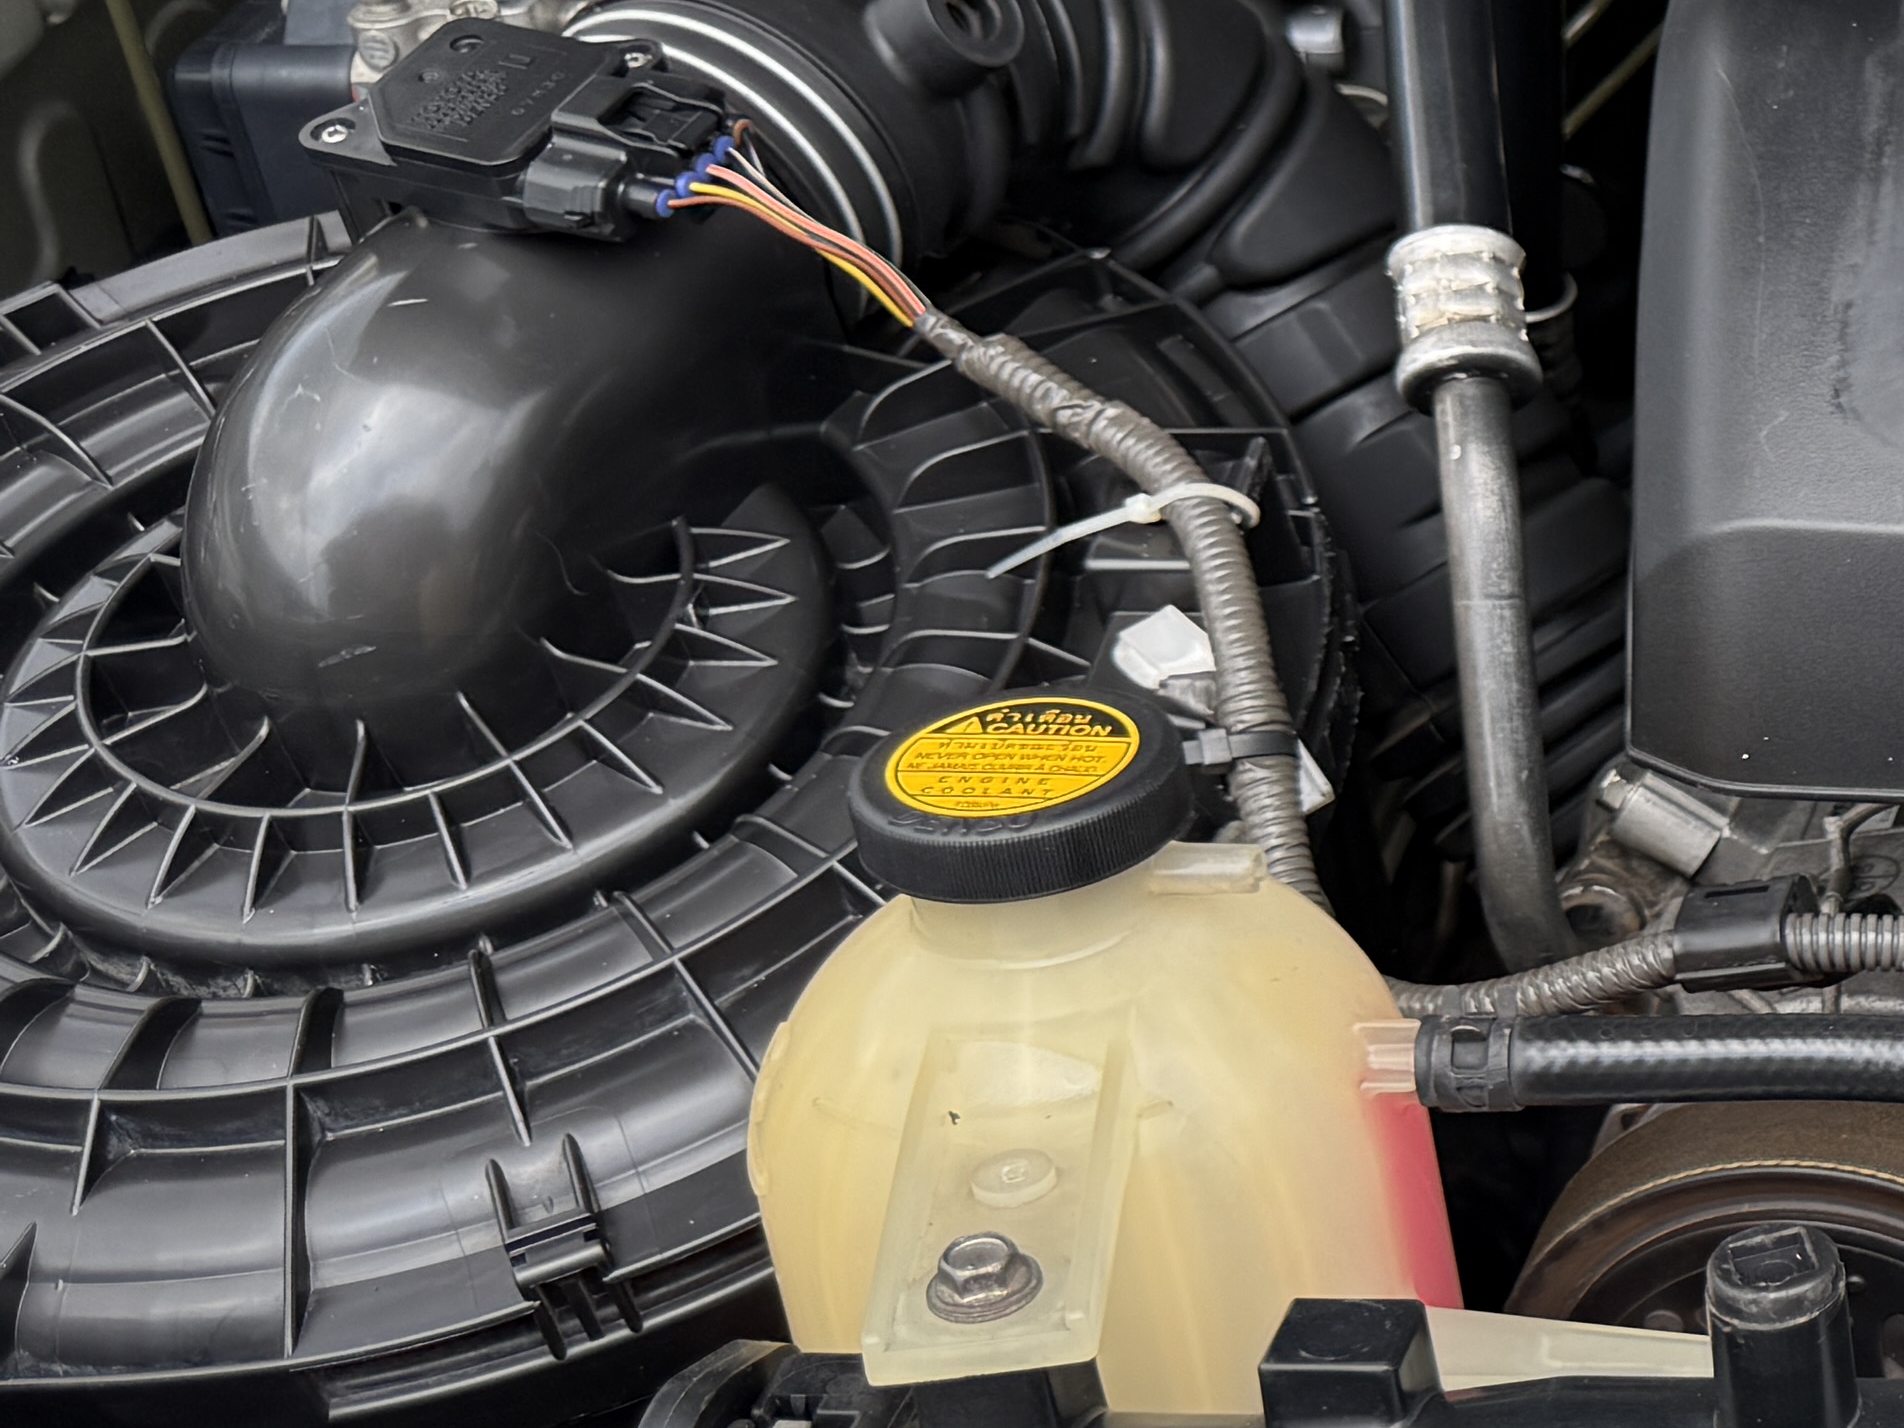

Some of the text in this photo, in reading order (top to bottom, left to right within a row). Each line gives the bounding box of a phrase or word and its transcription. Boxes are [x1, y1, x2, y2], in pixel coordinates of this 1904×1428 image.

[985, 723, 1113, 736] CAUTION
[914, 752, 968, 761] NEVER
[972, 752, 1016, 761] OPEN
[937, 775, 1053, 785] ENGINE
[919, 786, 1056, 796] COOLANT
